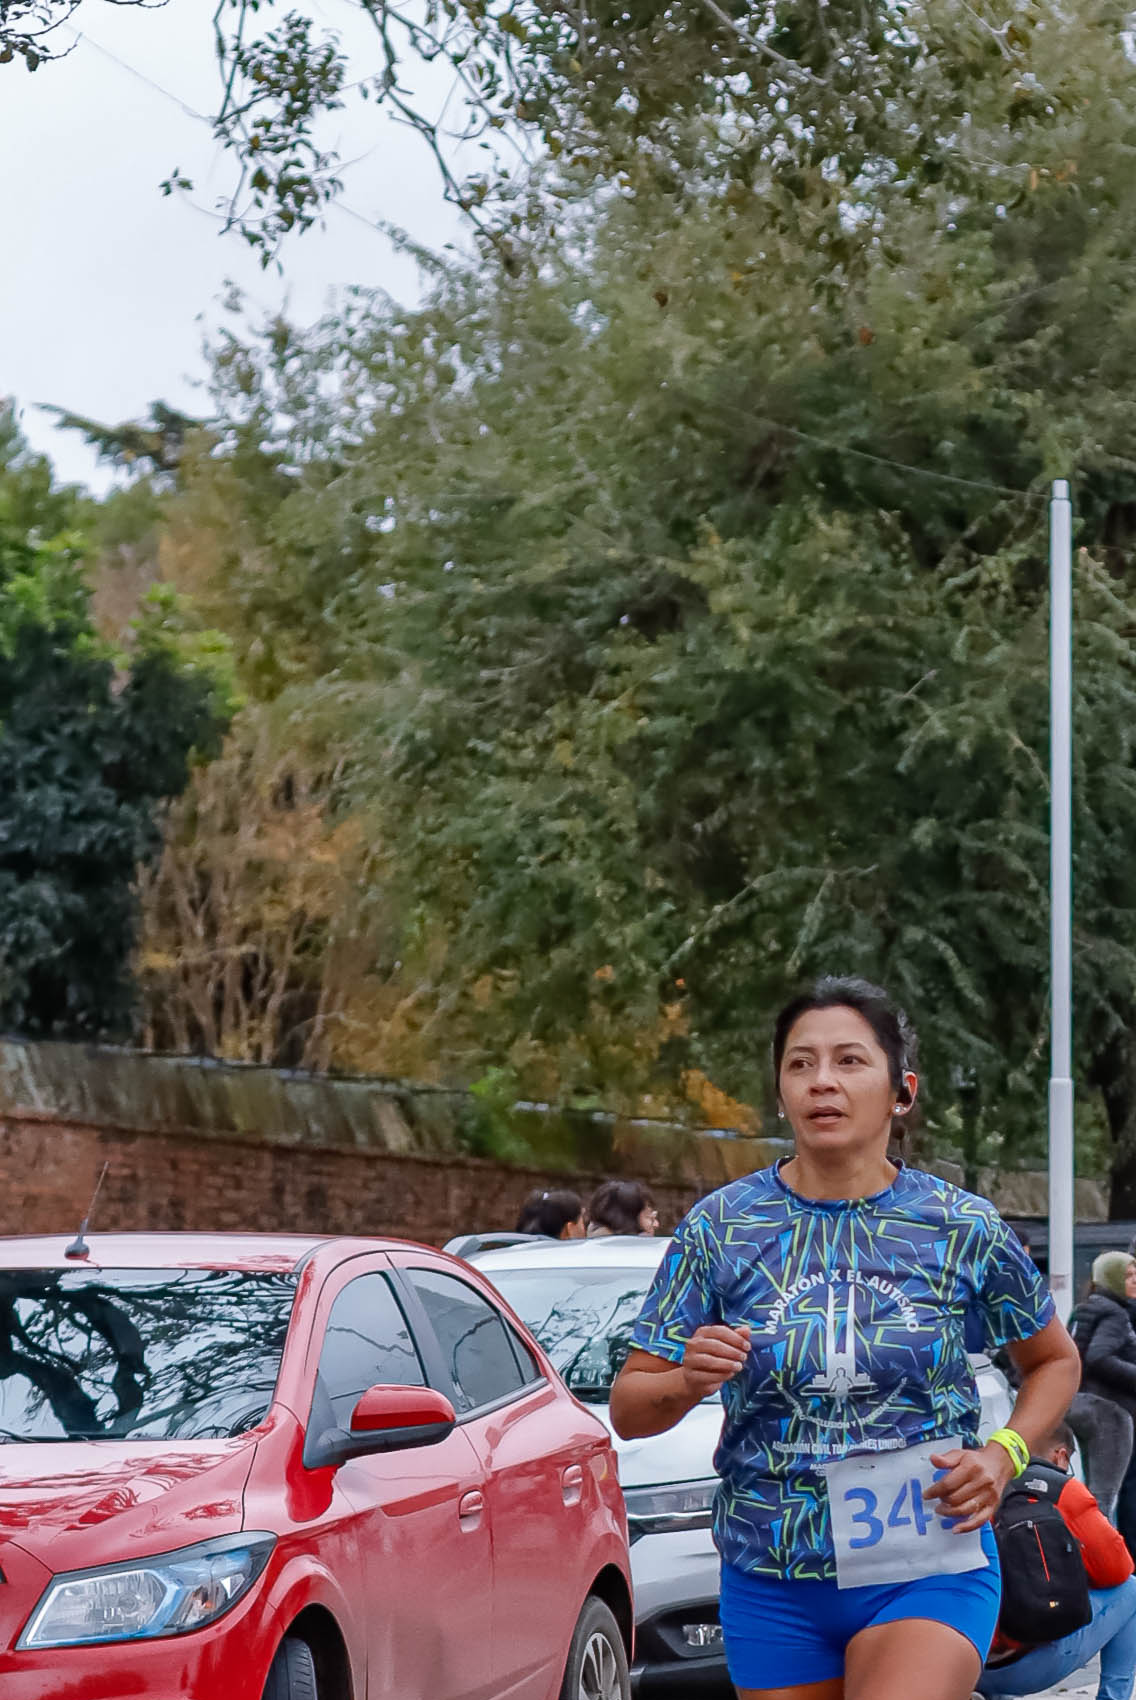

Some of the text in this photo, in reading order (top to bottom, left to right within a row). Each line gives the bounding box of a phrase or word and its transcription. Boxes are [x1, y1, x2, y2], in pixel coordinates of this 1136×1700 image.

[830, 1269, 842, 1283] X
[846, 1270, 865, 1284] EL
[868, 1275, 920, 1334] AUTISMO
[843, 1467, 973, 1549] 34
